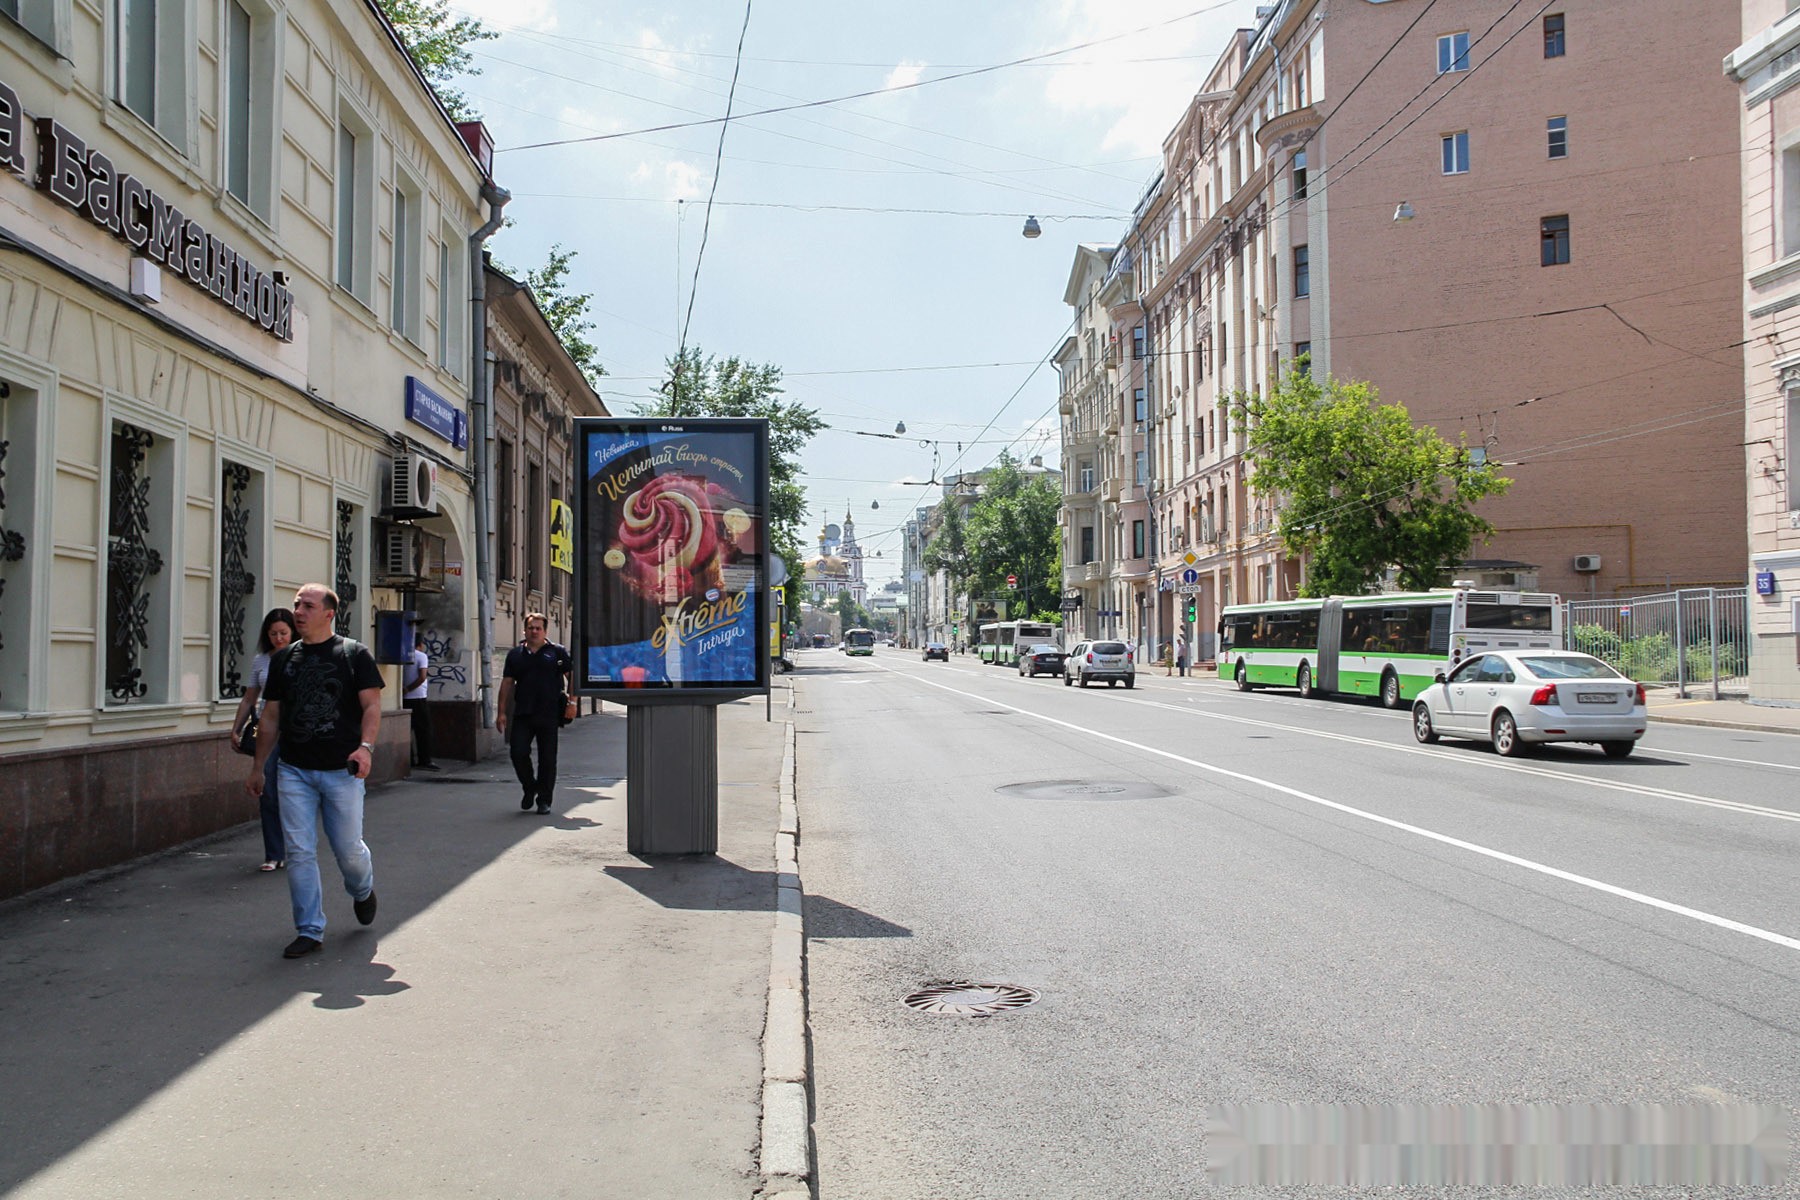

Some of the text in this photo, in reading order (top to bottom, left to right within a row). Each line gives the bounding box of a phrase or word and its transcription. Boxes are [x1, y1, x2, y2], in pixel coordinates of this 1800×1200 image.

[48, 118, 296, 343] Басманной
[597, 450, 675, 501] Испытай
[1758, 578, 1769, 589] 35
[697, 626, 745, 656] Intriga
